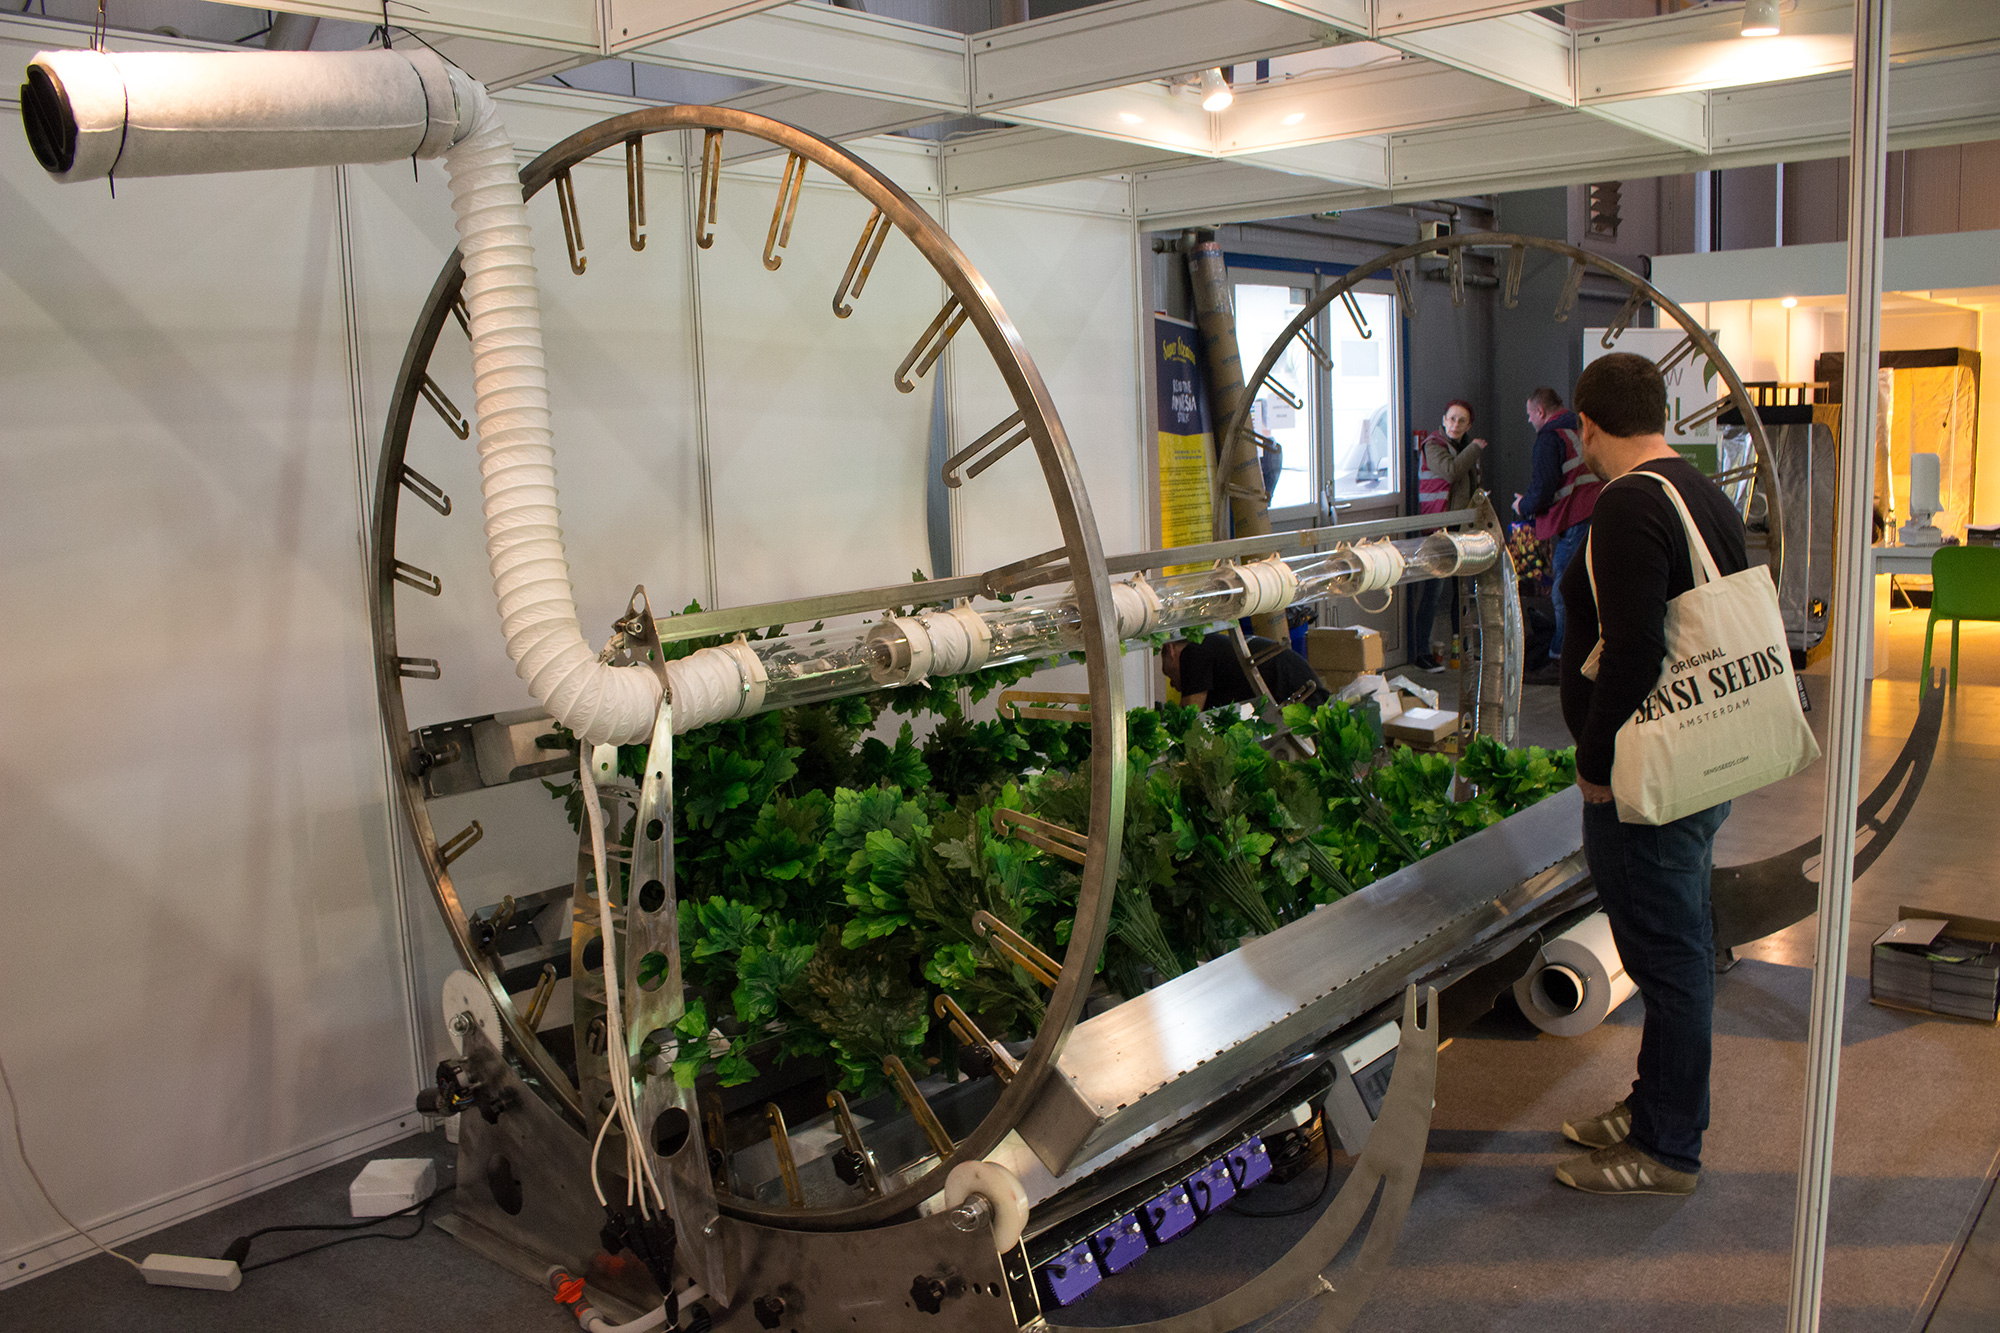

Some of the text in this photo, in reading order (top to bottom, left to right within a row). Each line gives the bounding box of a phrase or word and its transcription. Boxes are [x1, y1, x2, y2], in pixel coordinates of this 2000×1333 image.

[1171, 393, 1197, 412] AMNESIA
[1670, 646, 1727, 675] ORIGINAL
[1678, 697, 1751, 731] AMSTERDAM
